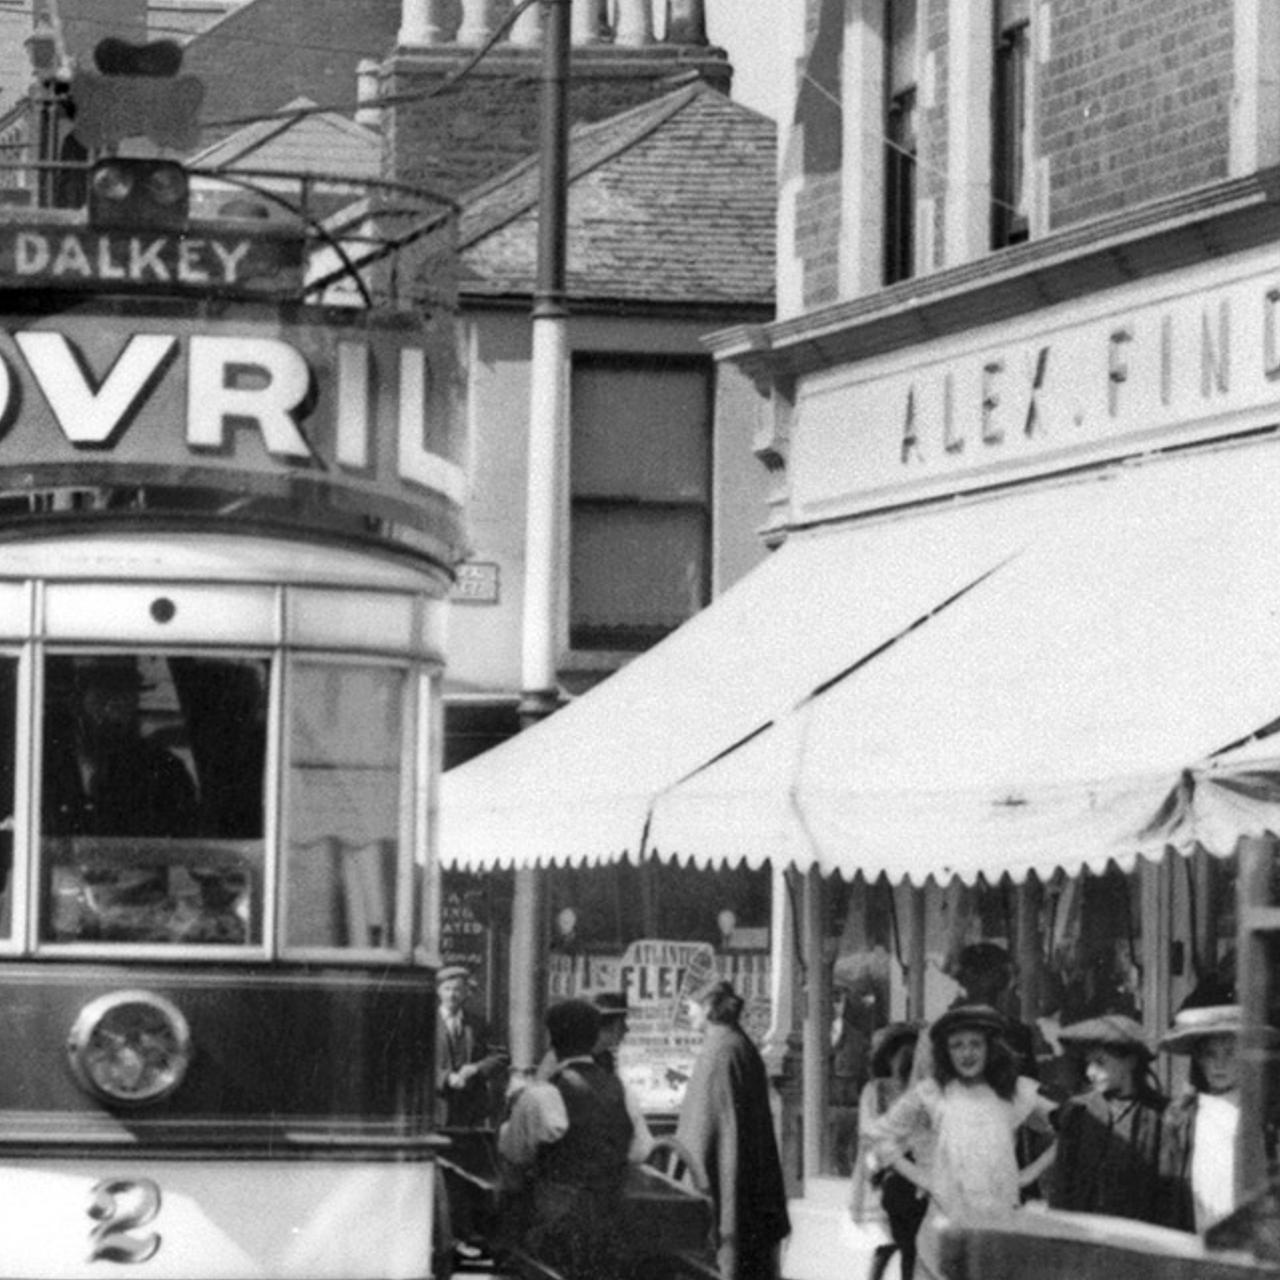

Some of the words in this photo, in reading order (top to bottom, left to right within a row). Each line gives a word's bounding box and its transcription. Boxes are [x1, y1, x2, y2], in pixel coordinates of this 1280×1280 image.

[15, 232, 251, 283] DALKEY
[901, 346, 1084, 464] ALEX.
[85, 1176, 162, 1264] 2
